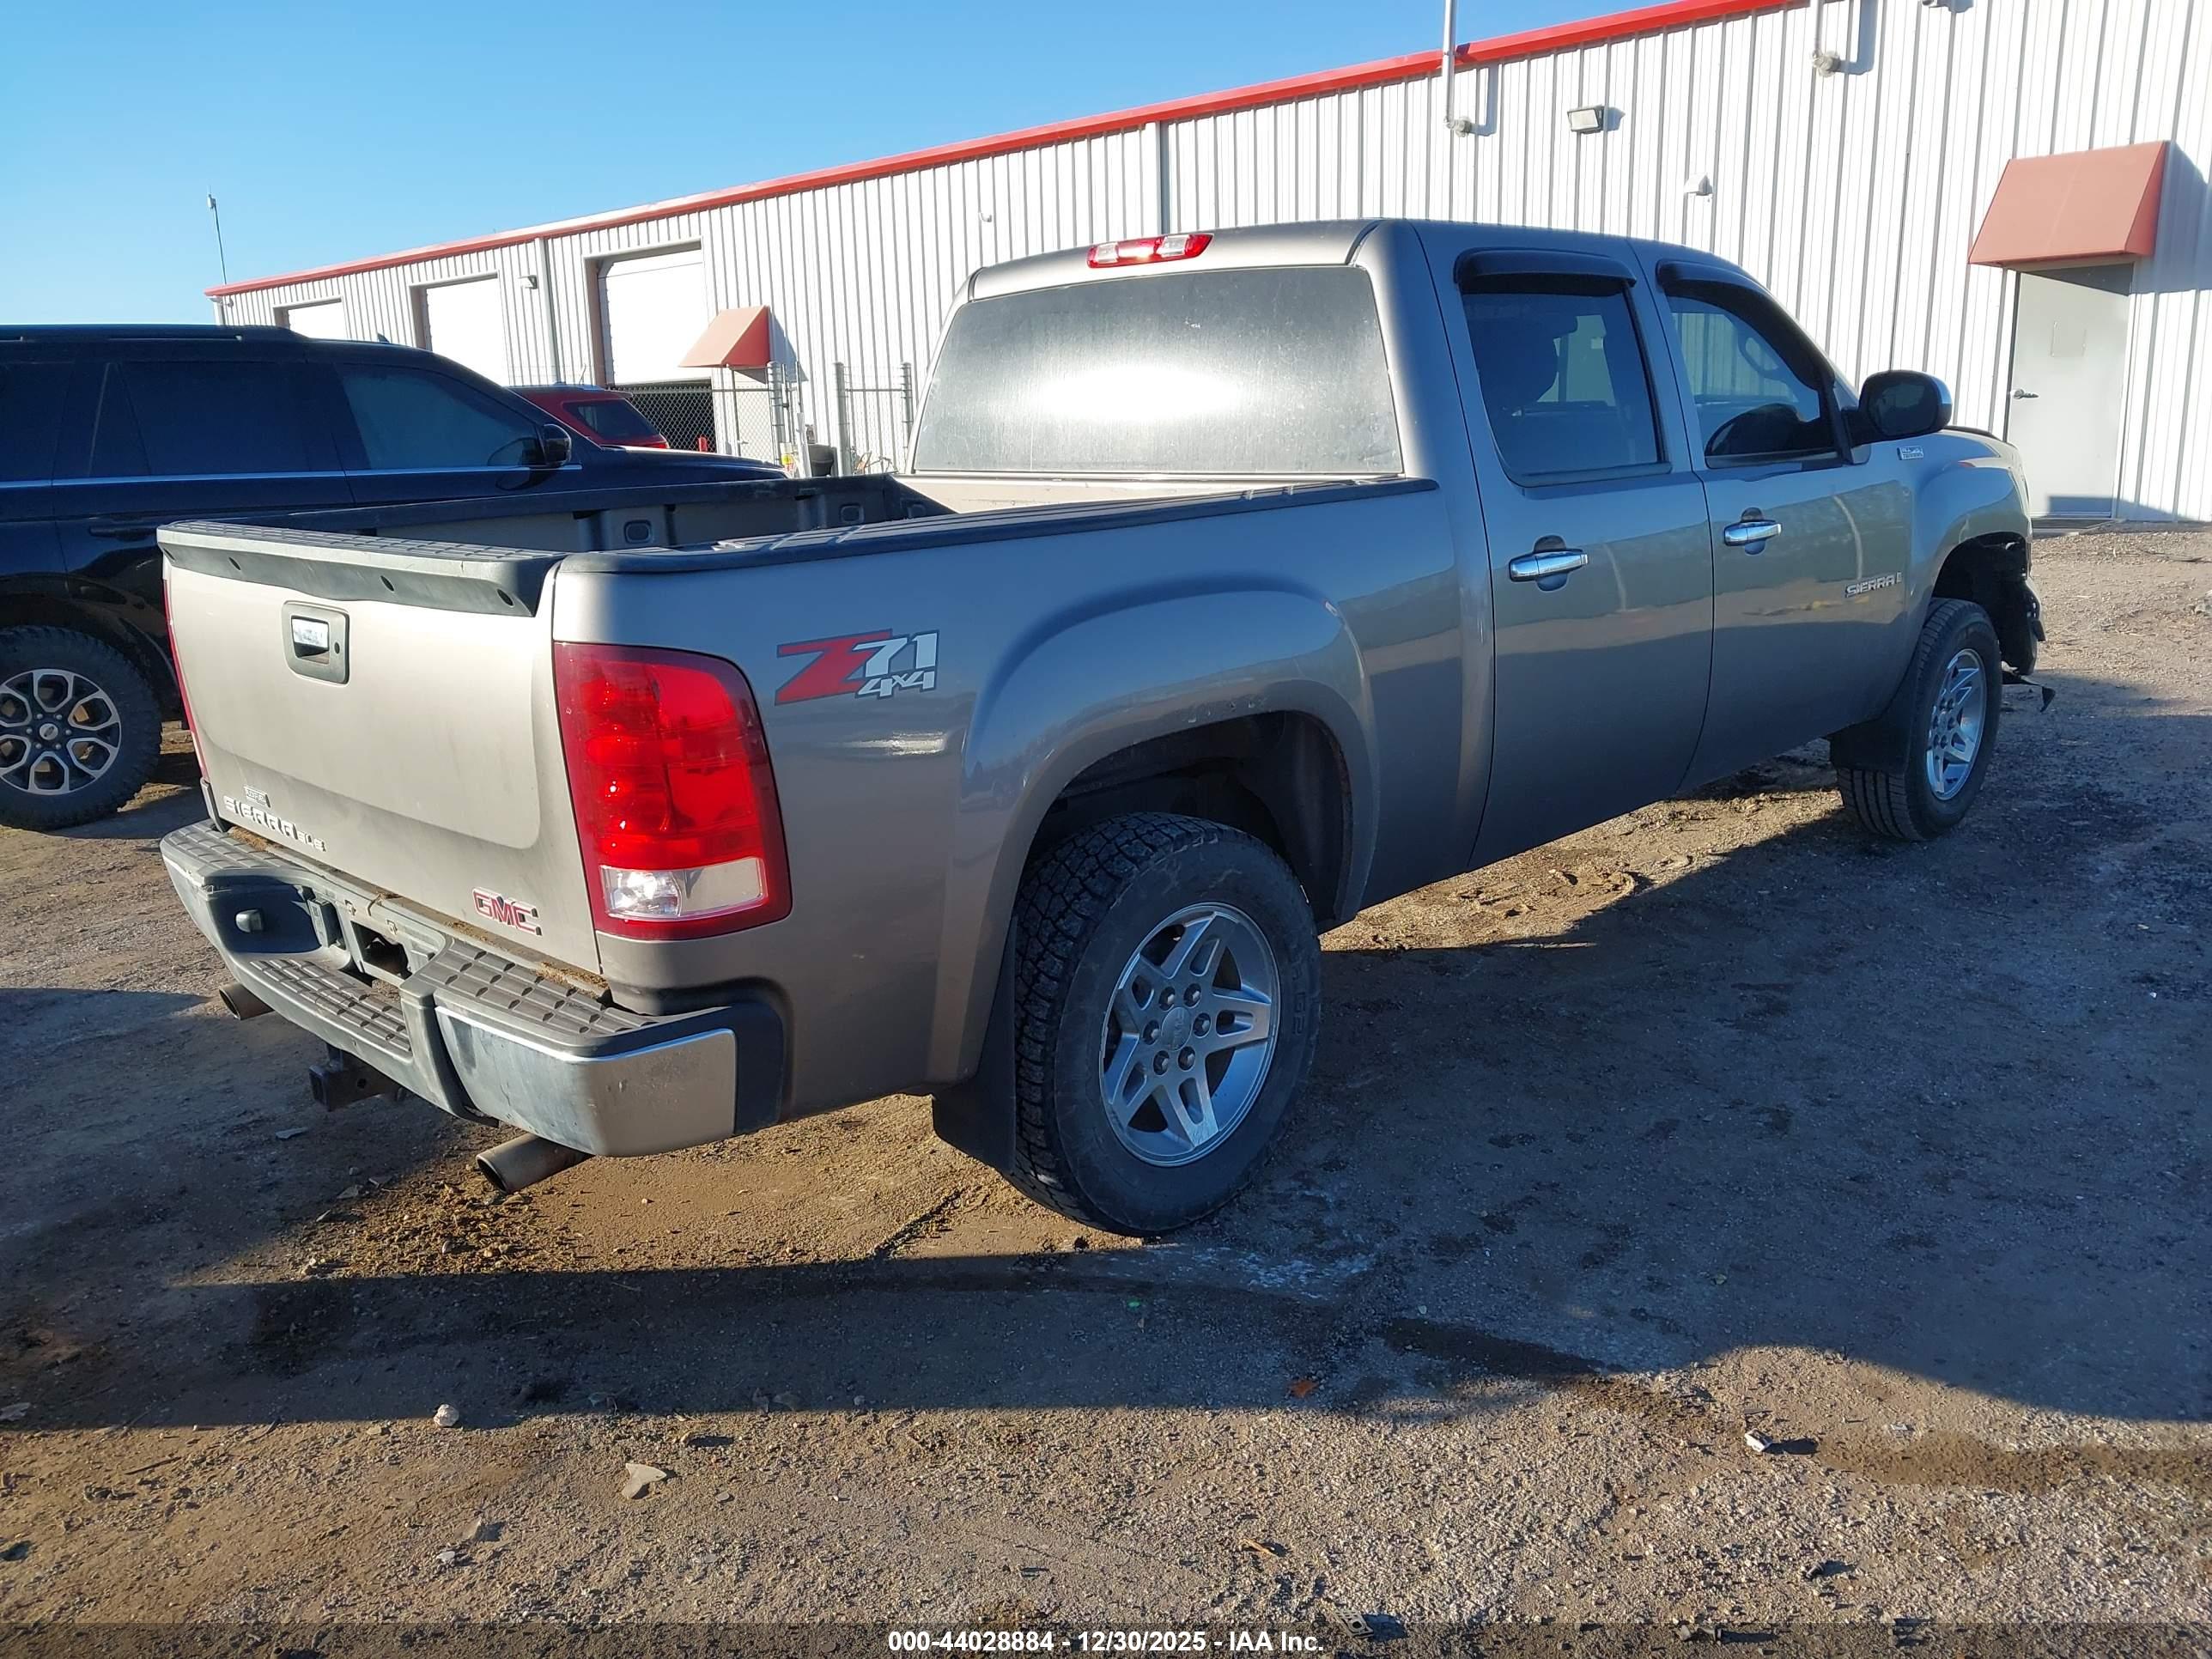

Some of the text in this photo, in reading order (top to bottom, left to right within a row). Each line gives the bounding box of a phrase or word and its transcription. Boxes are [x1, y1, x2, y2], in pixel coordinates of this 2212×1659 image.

[1845, 574, 1895, 596] SIERRA
[775, 629, 939, 705] Z71
[223, 796, 298, 840] SIERRA
[472, 887, 543, 937] GMC
